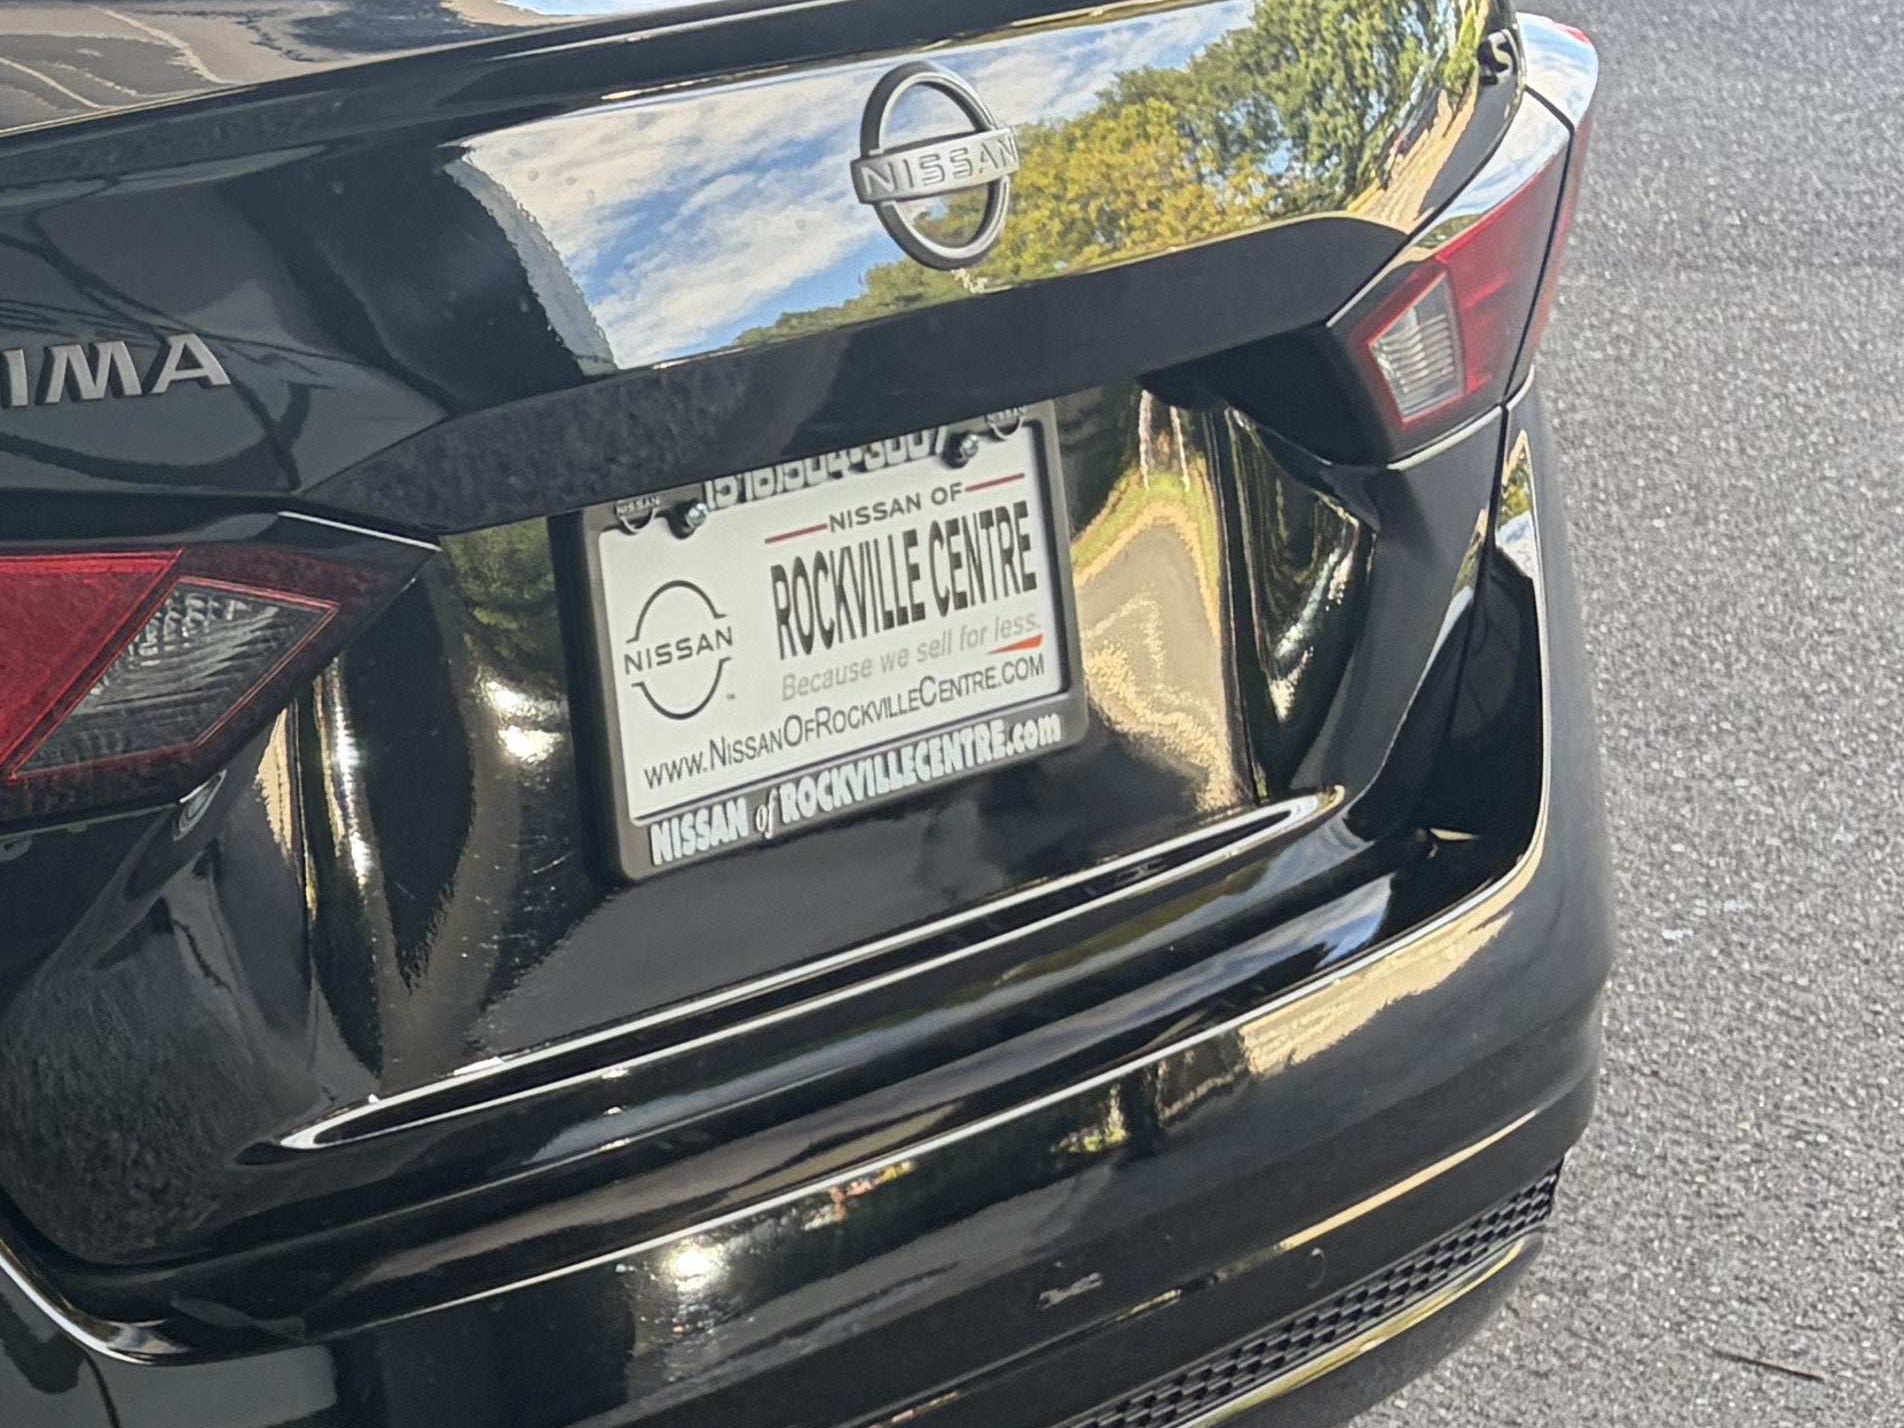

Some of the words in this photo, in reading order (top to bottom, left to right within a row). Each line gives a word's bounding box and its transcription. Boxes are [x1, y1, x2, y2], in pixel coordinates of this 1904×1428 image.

[861, 135, 1018, 200] NISSAN
[828, 492, 922, 533] NISSAN
[930, 481, 963, 506] OF
[769, 528, 927, 661] ROCKVILLE
[928, 499, 1038, 618] CENTRE
[623, 625, 733, 675] NISSAN
[780, 657, 874, 702] Because
[879, 649, 910, 674] we
[916, 630, 952, 664] sell
[958, 621, 988, 652] for
[993, 611, 1041, 642] less.
[649, 796, 750, 866] NISSAN
[755, 787, 778, 840] of
